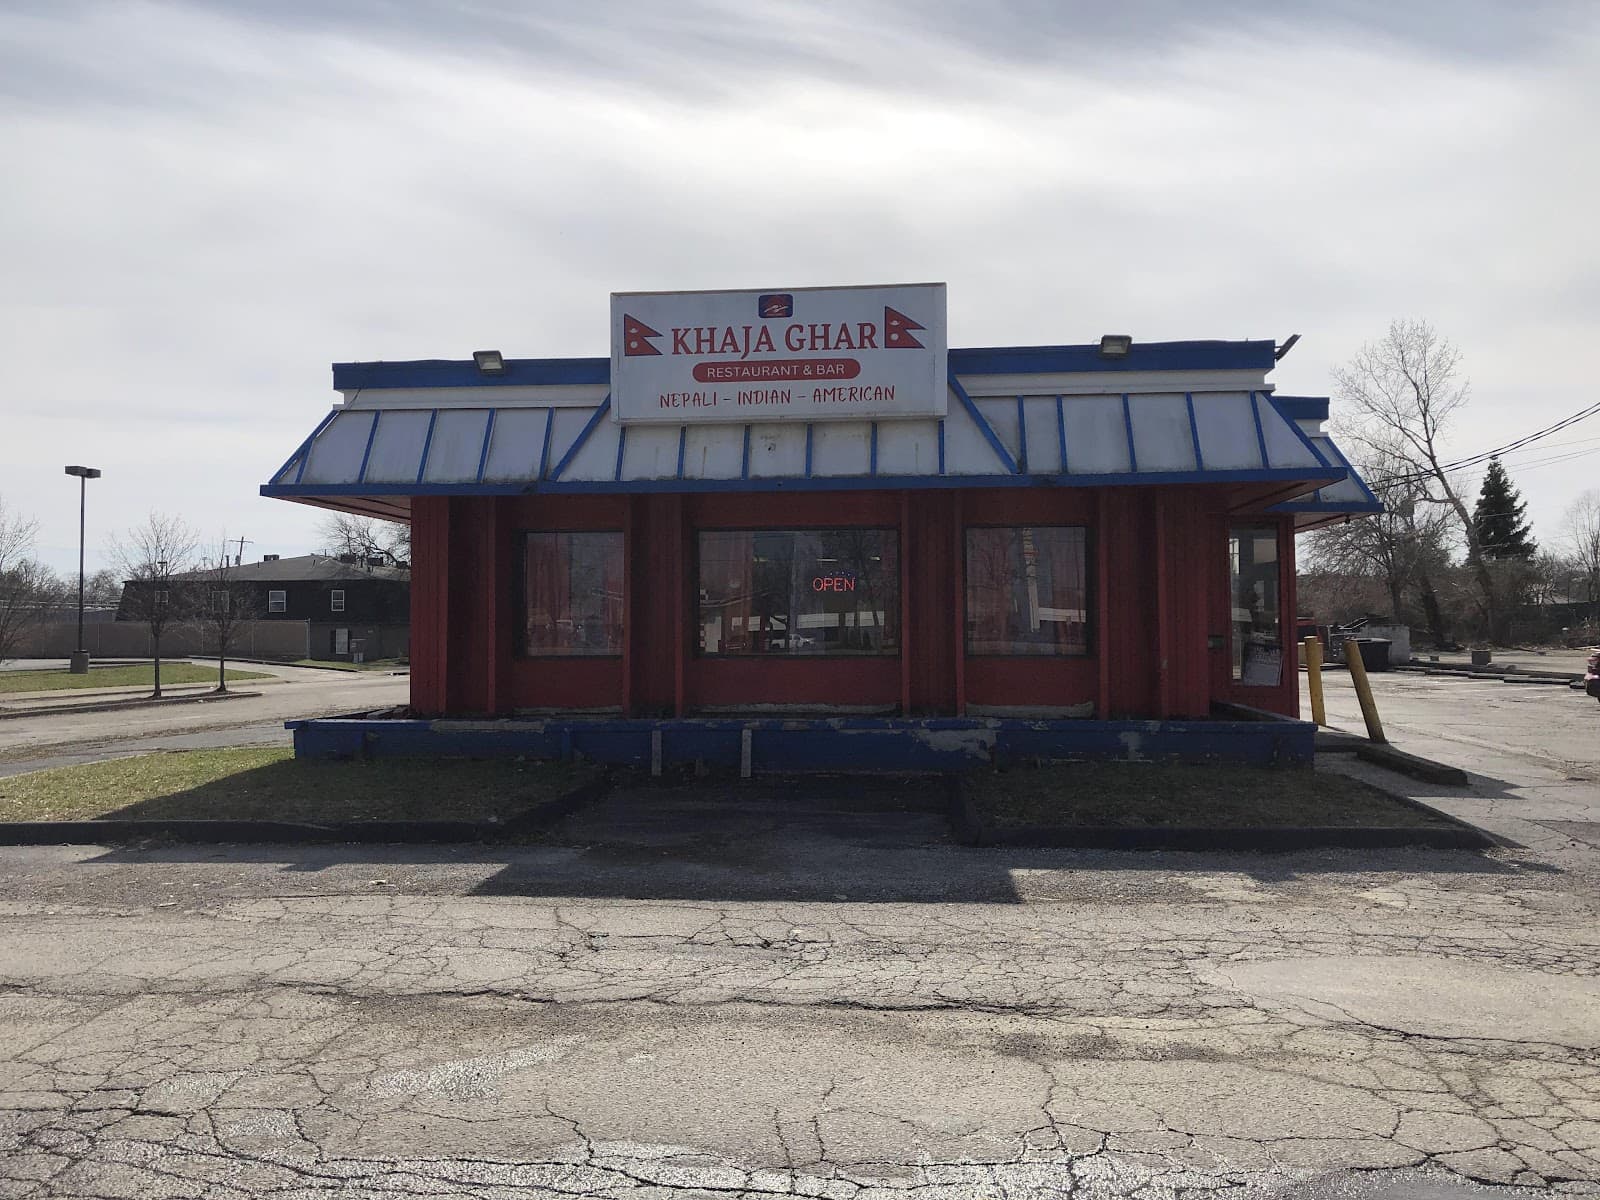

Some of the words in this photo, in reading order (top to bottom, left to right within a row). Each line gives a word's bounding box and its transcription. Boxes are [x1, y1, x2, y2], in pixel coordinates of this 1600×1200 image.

[671, 324, 777, 360] KHAJA
[784, 322, 879, 352] GHAR
[707, 365, 800, 378] RESTAURANT
[802, 364, 812, 376] &
[816, 363, 845, 375] BAR
[660, 391, 717, 408] NEPALI
[738, 388, 791, 405] INDIAN
[813, 384, 895, 403] AMERICAN
[813, 577, 855, 591] OPEN
